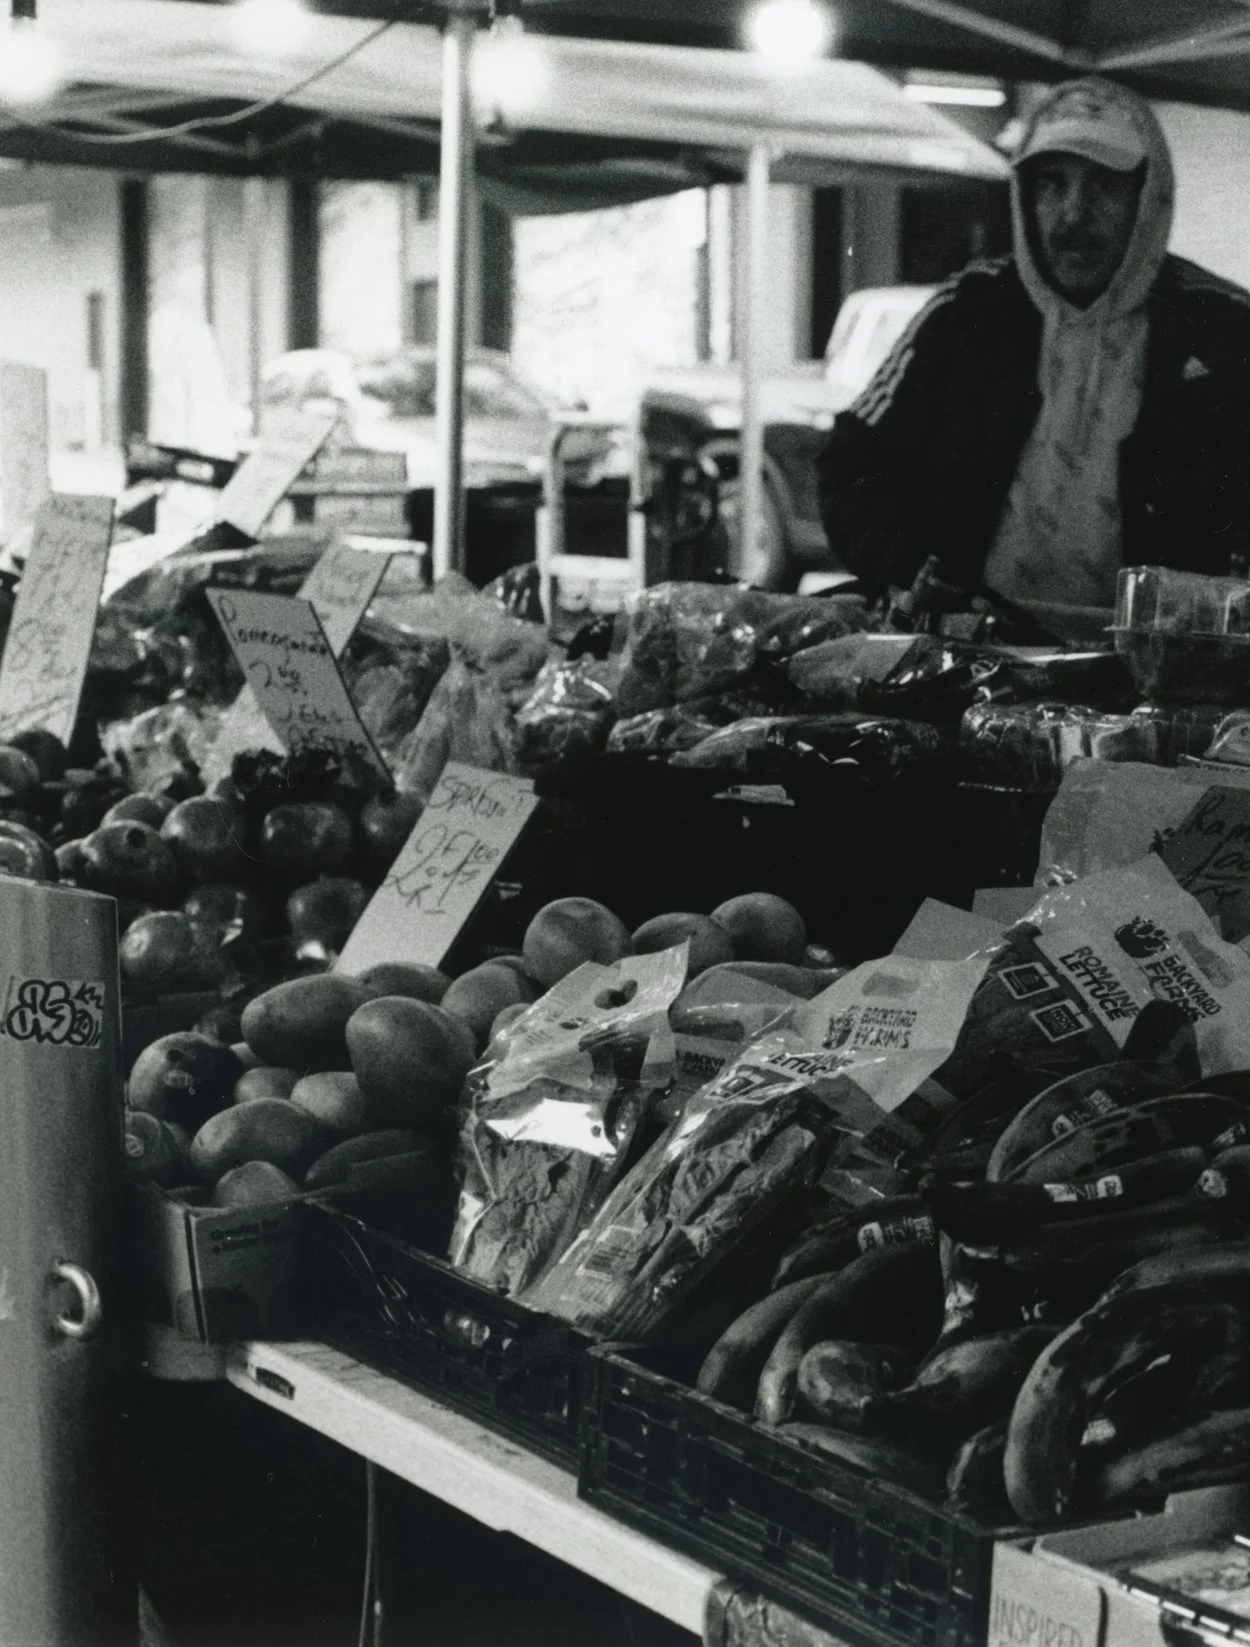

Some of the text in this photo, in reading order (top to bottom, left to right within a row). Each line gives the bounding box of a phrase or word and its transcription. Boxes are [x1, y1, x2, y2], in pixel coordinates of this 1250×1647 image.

[1057, 951, 1130, 1021] LETTUCE
[1073, 945, 1140, 1019] ROMAINE
[1164, 954, 1222, 1018] BACKYARD
